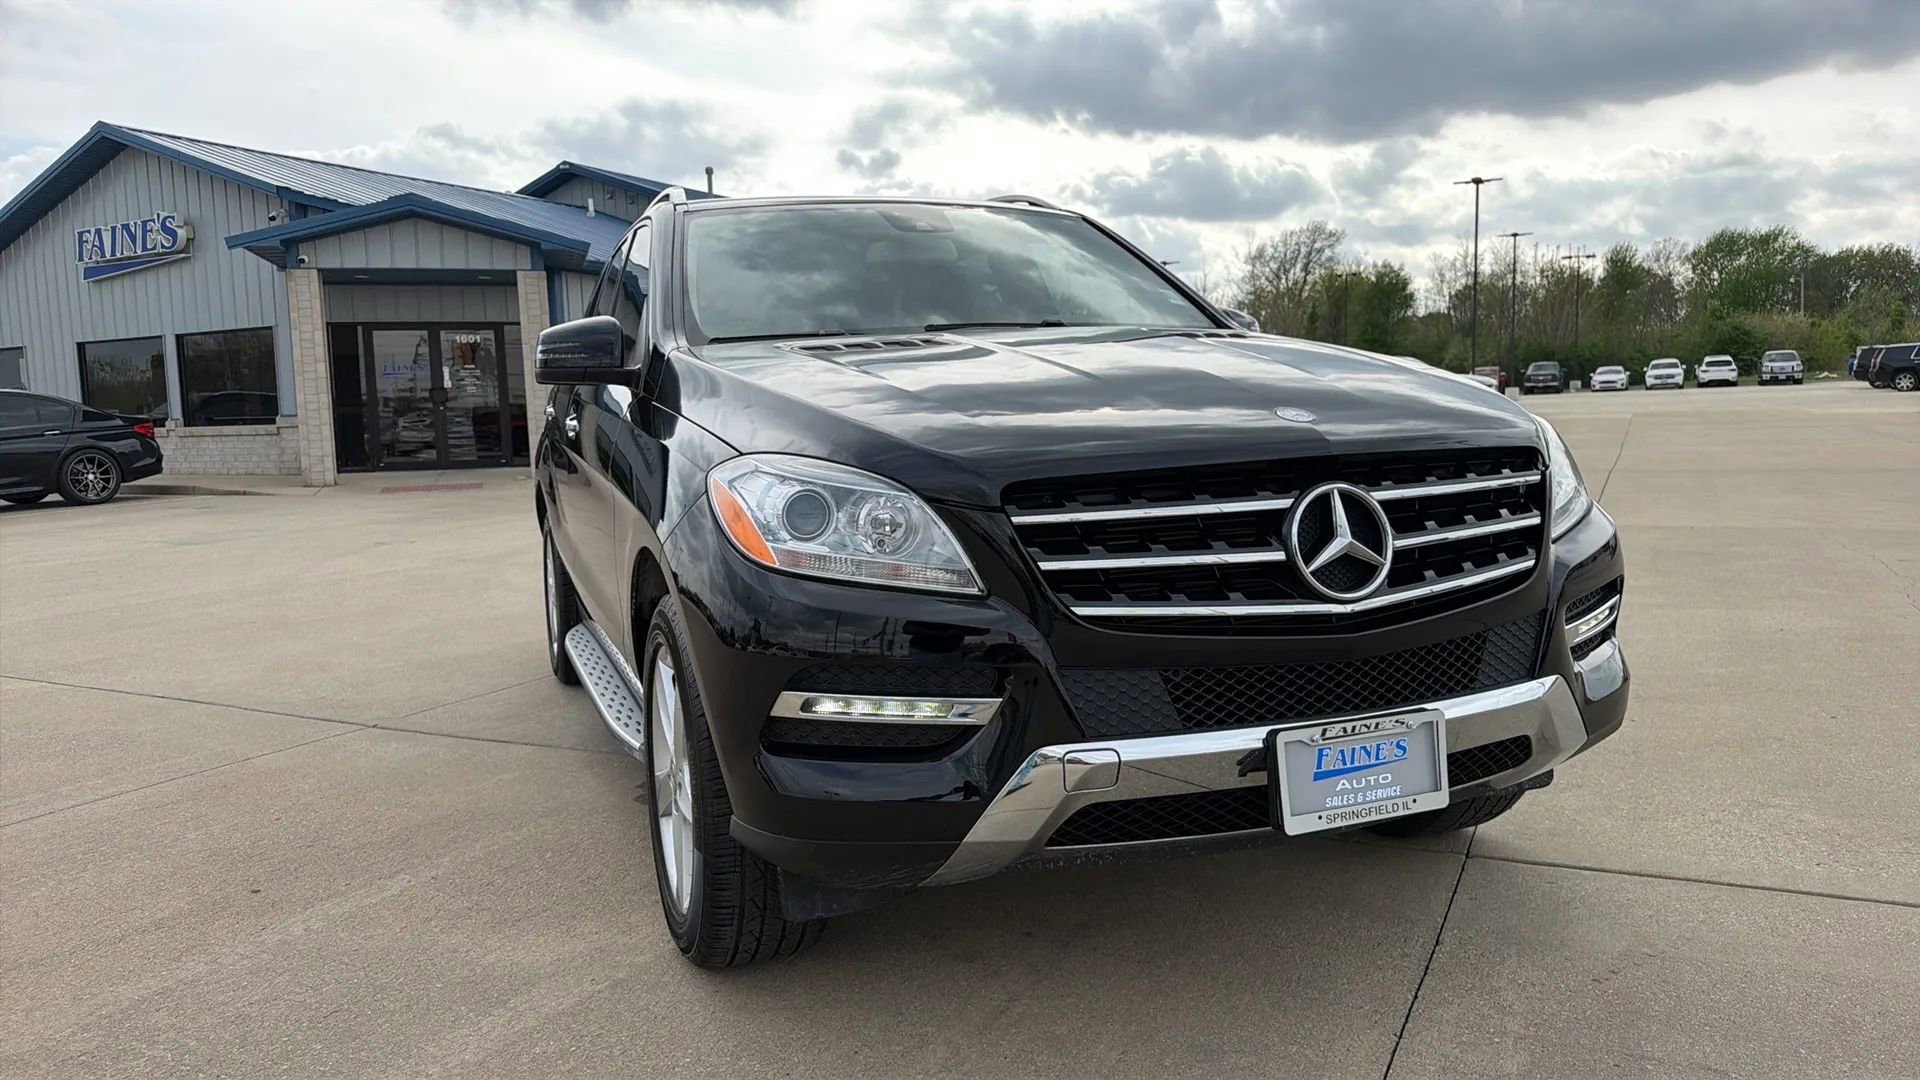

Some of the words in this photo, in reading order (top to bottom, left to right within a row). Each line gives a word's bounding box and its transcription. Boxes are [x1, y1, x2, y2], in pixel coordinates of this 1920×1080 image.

[76, 212, 179, 263] FAINE'S
[456, 335, 480, 343] 1601
[1320, 717, 1406, 737] FAINE'S
[1315, 738, 1408, 771] FAINE'S
[1336, 773, 1392, 791] AUTO
[1325, 792, 1355, 807] SALES
[1366, 785, 1402, 801] SERVICE
[1326, 802, 1399, 825] SPRINGFIELD
[1402, 801, 1412, 811] IL
